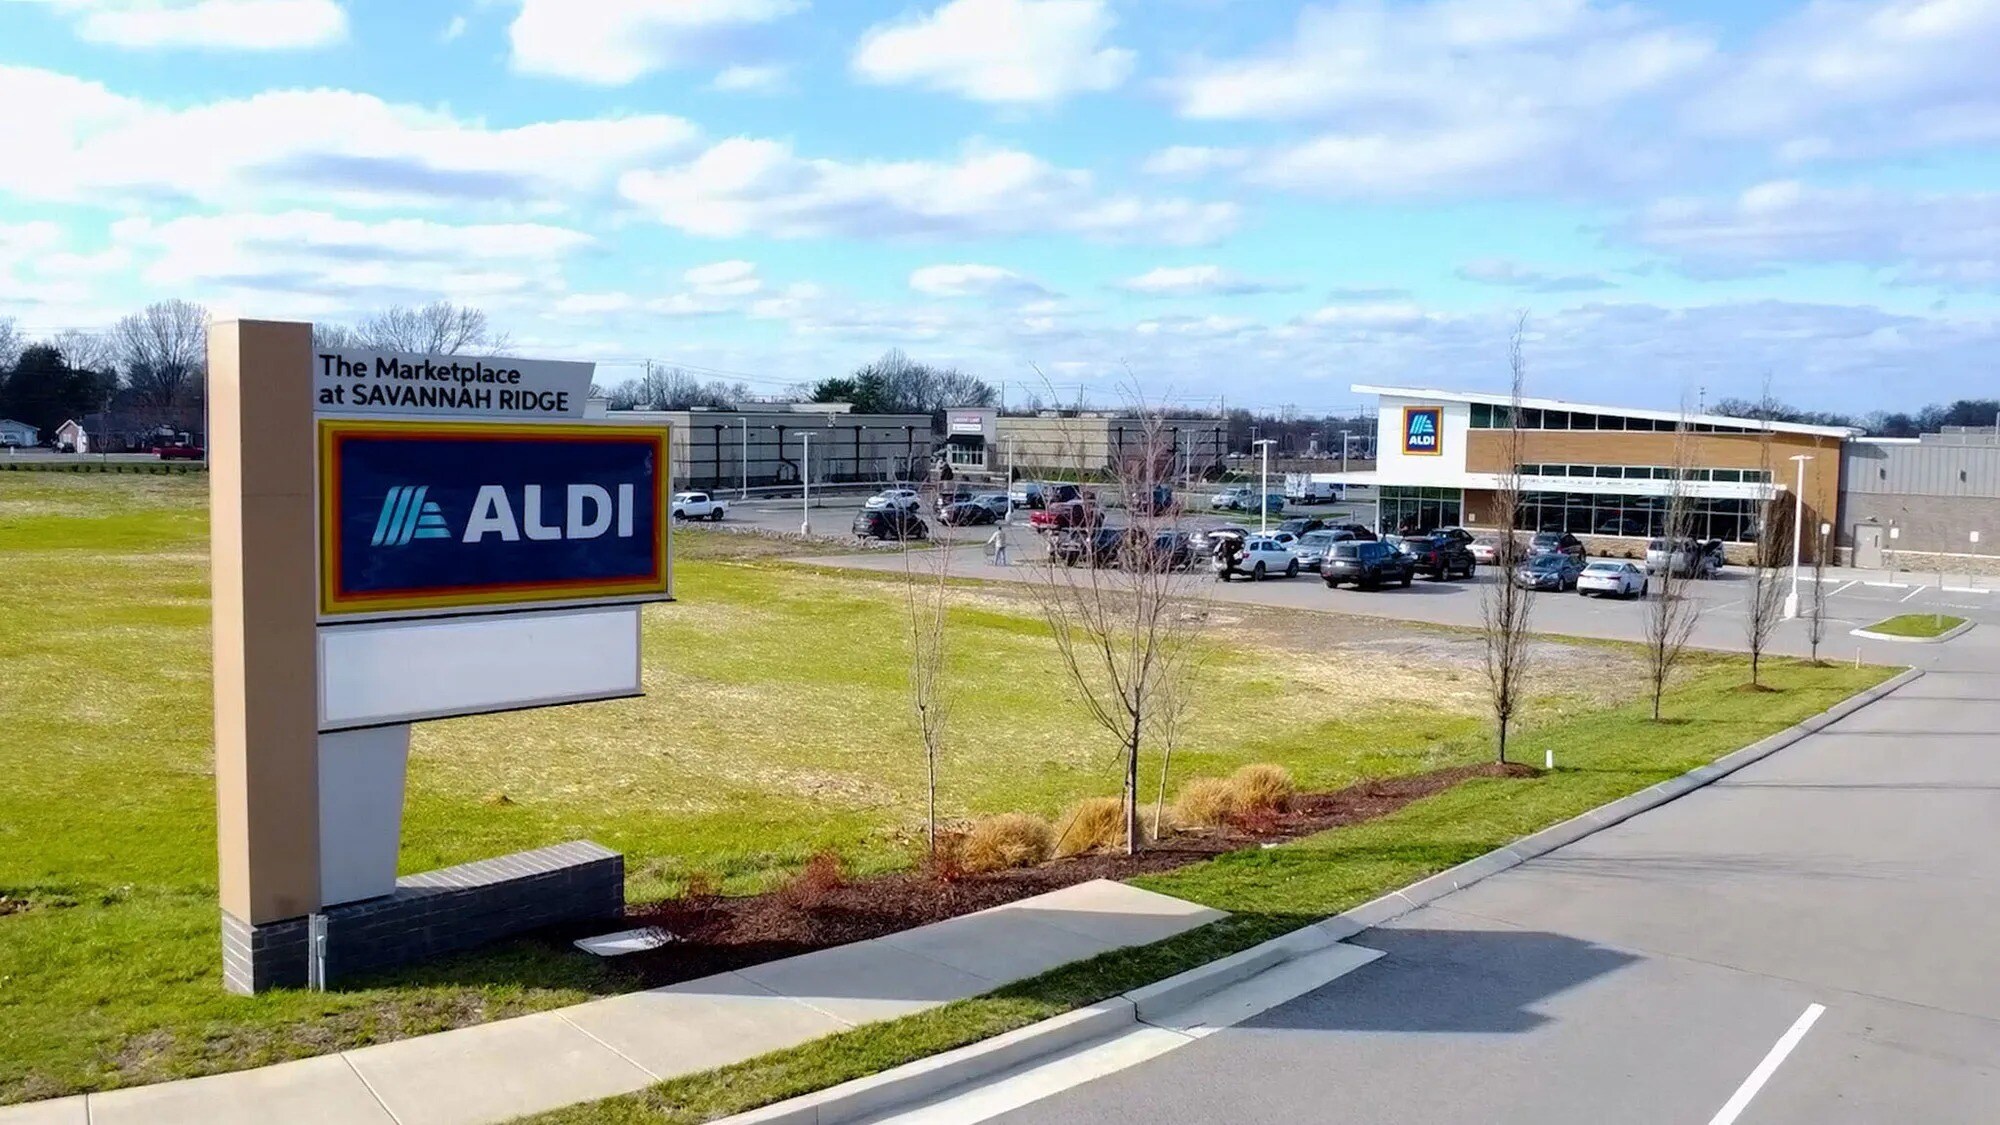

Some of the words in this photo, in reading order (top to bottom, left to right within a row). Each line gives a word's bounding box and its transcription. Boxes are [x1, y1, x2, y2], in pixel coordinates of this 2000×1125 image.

[319, 354, 367, 378] The
[375, 357, 521, 386] Marketplace
[319, 386, 345, 405] at
[352, 385, 492, 409] SAVANNAH
[499, 390, 569, 412] RIDGE
[1409, 435, 1435, 446] ALDI
[462, 483, 634, 543] ALDI
